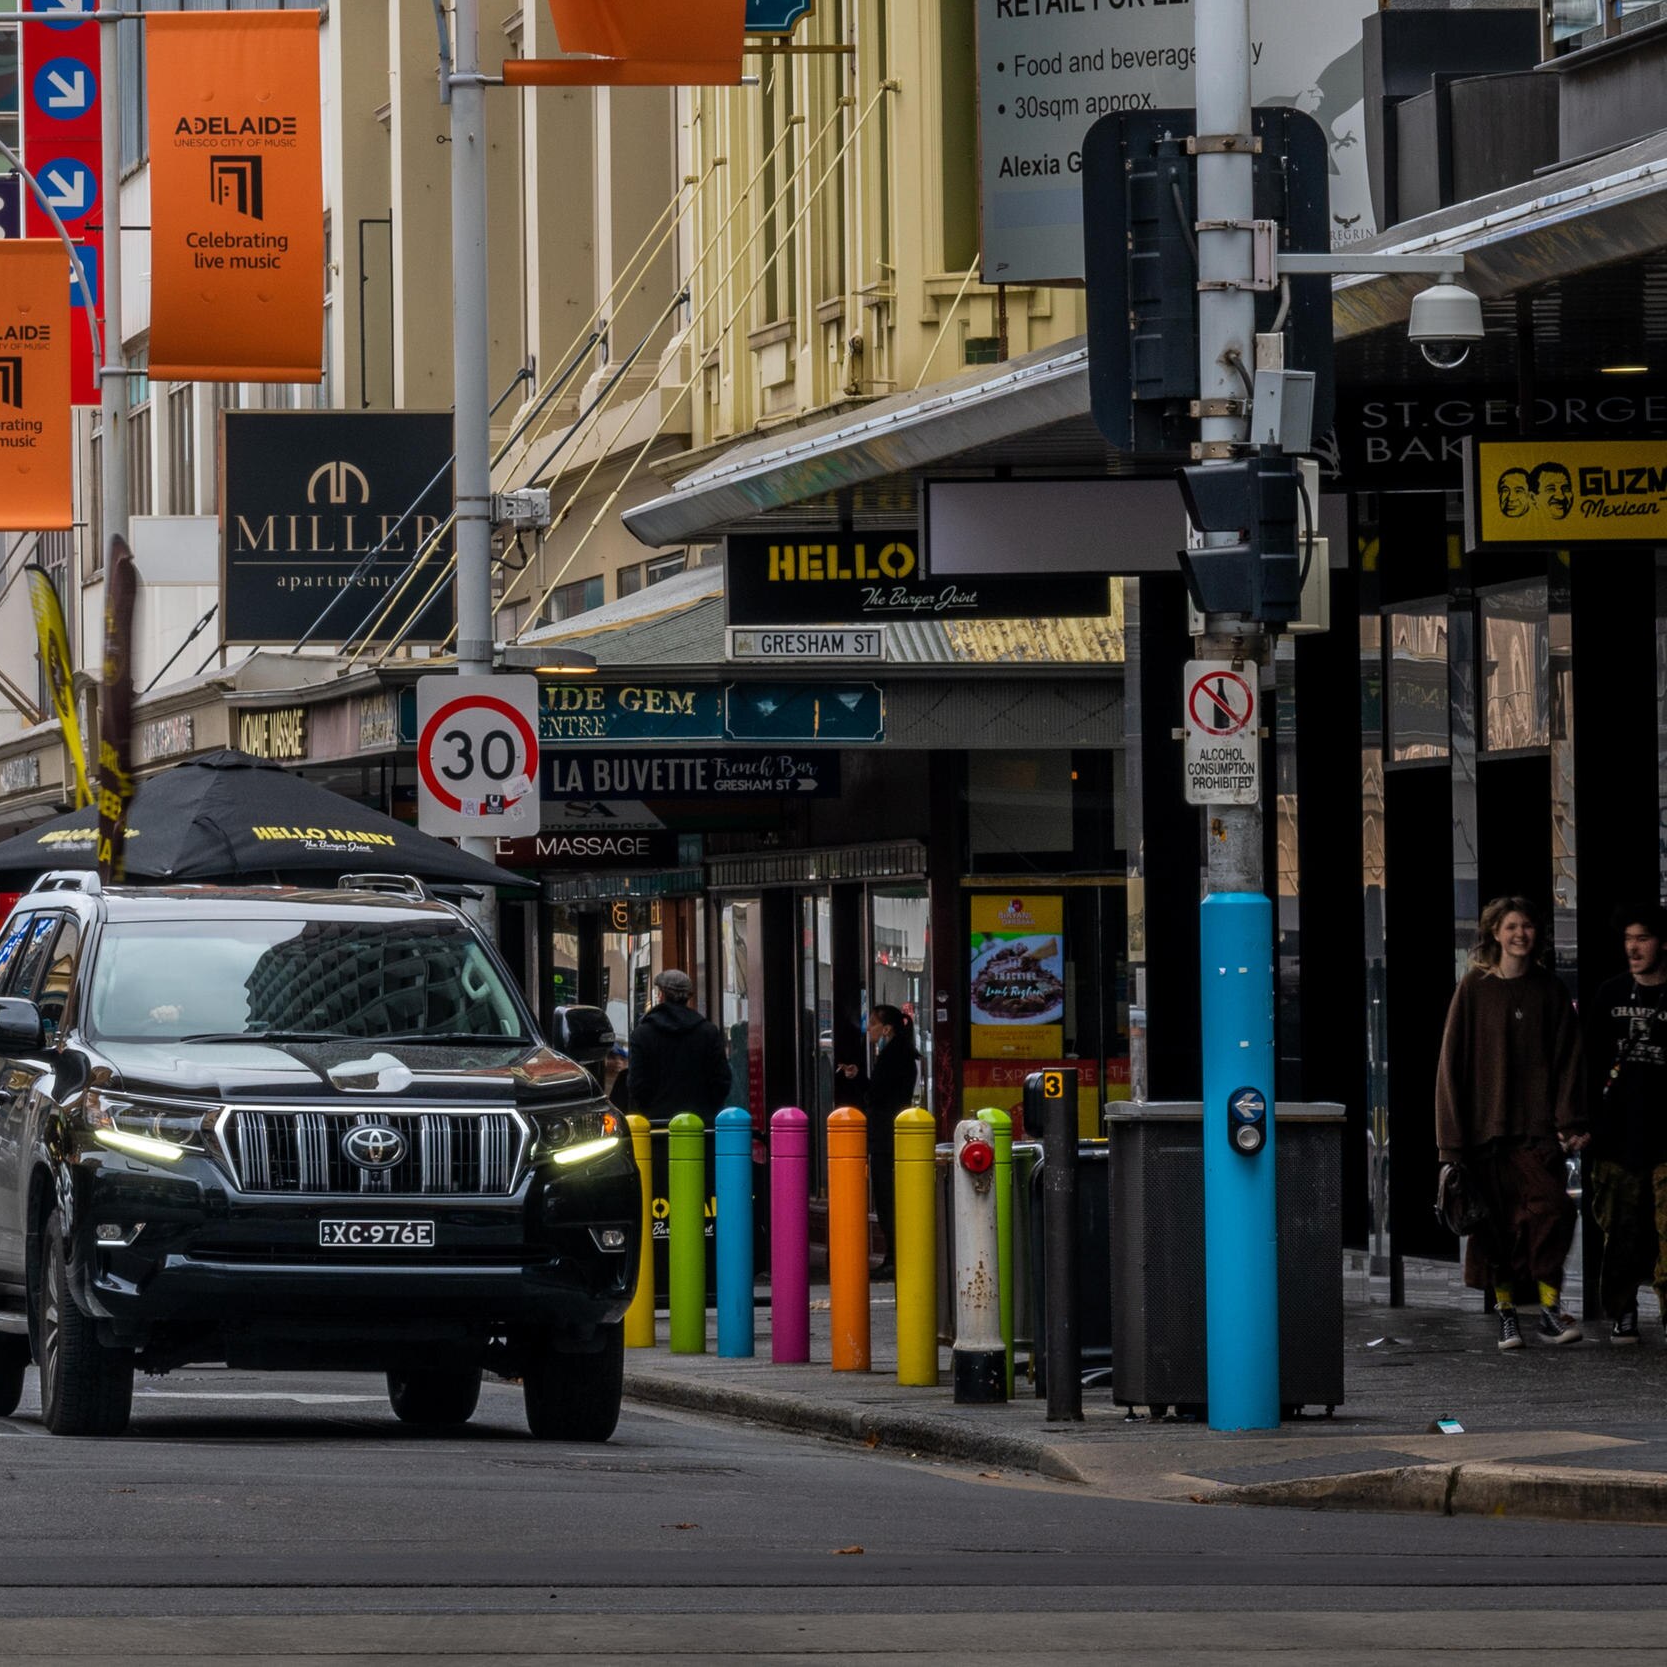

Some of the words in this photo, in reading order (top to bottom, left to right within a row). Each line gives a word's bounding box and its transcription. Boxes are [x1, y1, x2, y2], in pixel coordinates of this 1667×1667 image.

[1014, 52, 1062, 78] Food
[1069, 48, 1104, 74] and
[1015, 95, 1079, 122] 30sqm
[1086, 92, 1157, 119] approx.
[175, 117, 297, 135] ADELAIDE
[174, 138, 217, 148] UNESCO
[221, 138, 244, 147] CITY
[247, 138, 261, 147] OF
[265, 138, 297, 147] MUSIC
[999, 153, 1061, 179] Alexia
[186, 232, 289, 252] Celebrating
[194, 252, 224, 269] live
[230, 253, 281, 269] music
[1580, 499, 1660, 519] Mexican
[234, 515, 445, 552] MILLER
[769, 542, 916, 581] HELLO
[277, 573, 401, 592] apartments
[861, 587, 886, 607] The
[889, 586, 935, 611] Burger
[934, 585, 978, 611] Joint
[761, 634, 844, 654] GRESHAM
[853, 634, 874, 654] ST
[619, 687, 697, 716] GEM
[441, 729, 516, 781] 30
[1199, 748, 1246, 761] ALCOHOL
[553, 759, 584, 793] LA
[594, 758, 708, 792] BUVETTE
[711, 755, 775, 778] French
[776, 755, 818, 778] Bar
[1187, 762, 1255, 775] CONSUMPTION
[714, 779, 772, 791] GRESHAM
[776, 779, 791, 791] ST
[1192, 776, 1253, 789] PROHIBITED
[251, 826, 327, 841] HELLO
[327, 829, 397, 847] HARRY
[540, 821, 661, 832] onvenience
[317, 840, 347, 851] Burger
[536, 837, 651, 855] MASSAGE
[1046, 1075, 1061, 1096] 3
